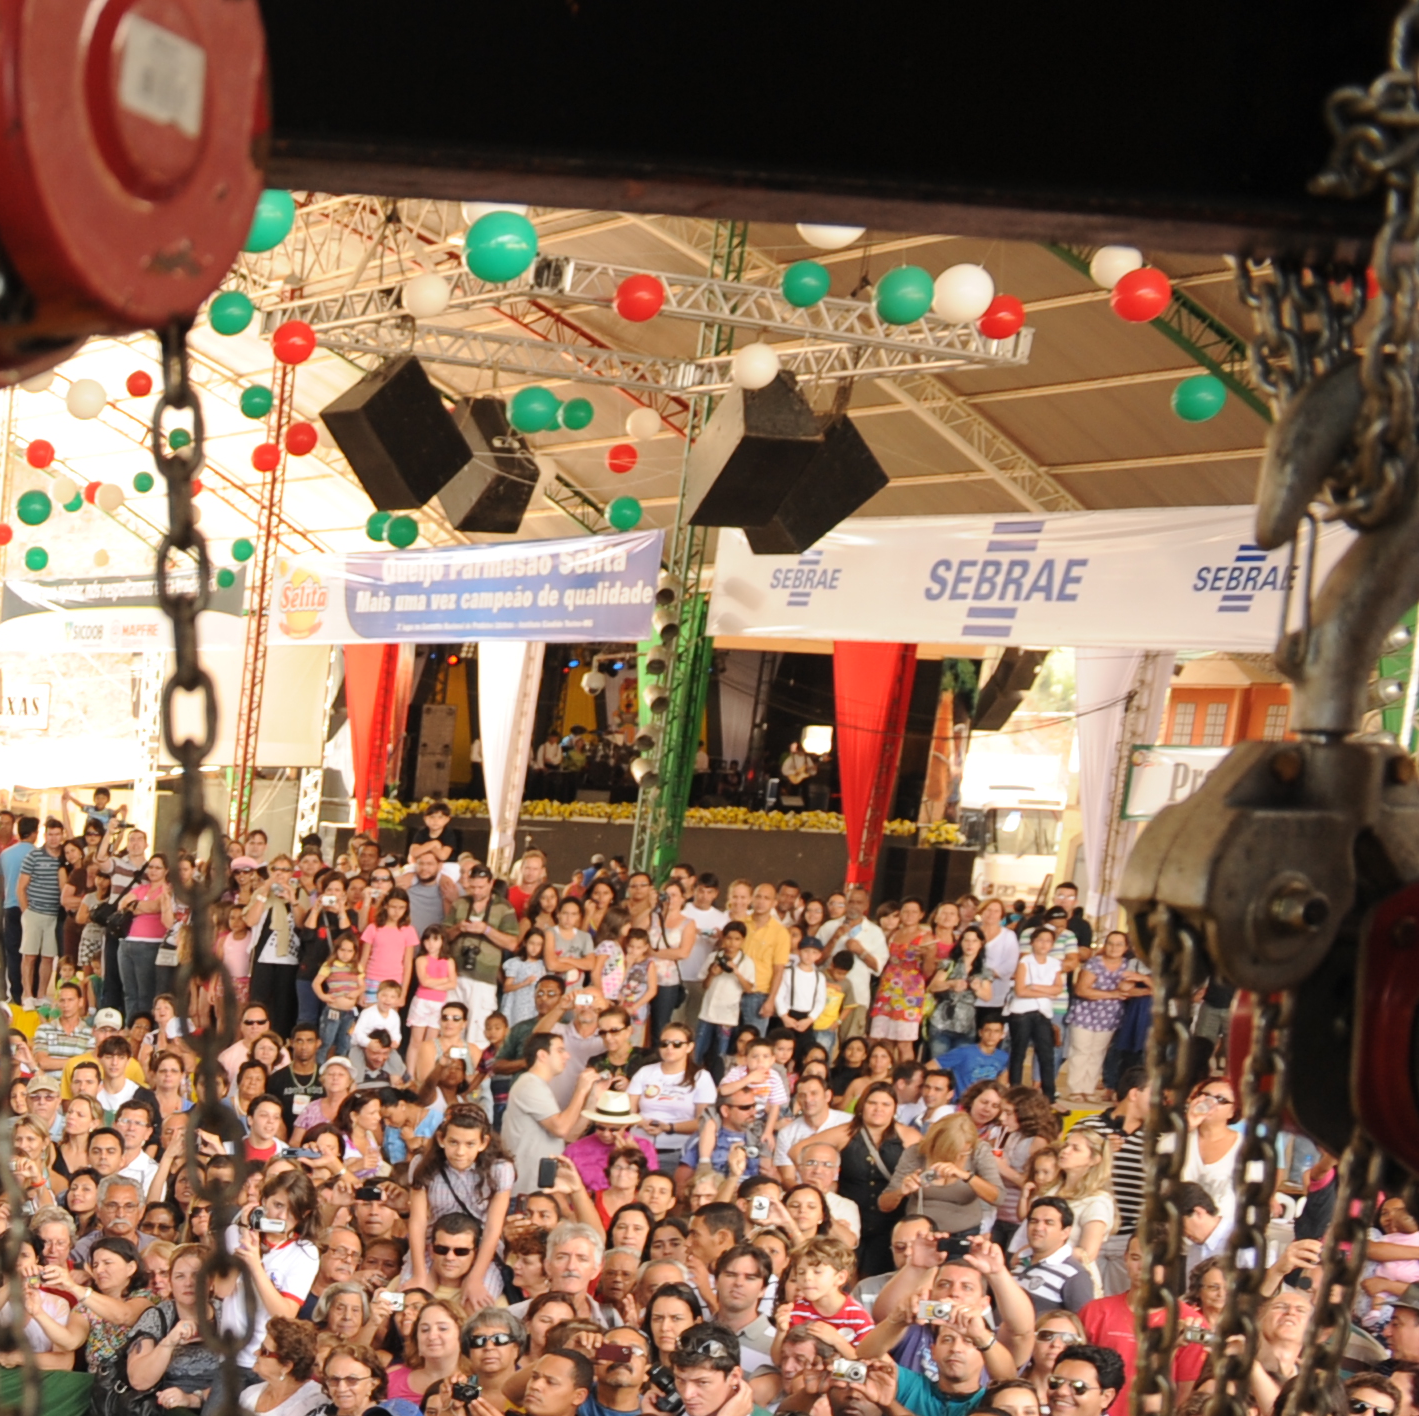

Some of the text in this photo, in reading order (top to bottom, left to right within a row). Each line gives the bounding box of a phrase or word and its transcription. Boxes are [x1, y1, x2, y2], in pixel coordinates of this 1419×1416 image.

[770, 568, 842, 591] SEBRAE
[924, 558, 1089, 602] SEBRAE
[1193, 565, 1300, 592] SEBRAE
[279, 578, 328, 613] Selita
[355, 579, 653, 613] Mais uma vez campeão de qualidade
[122, 623, 159, 637] MAPFRE
